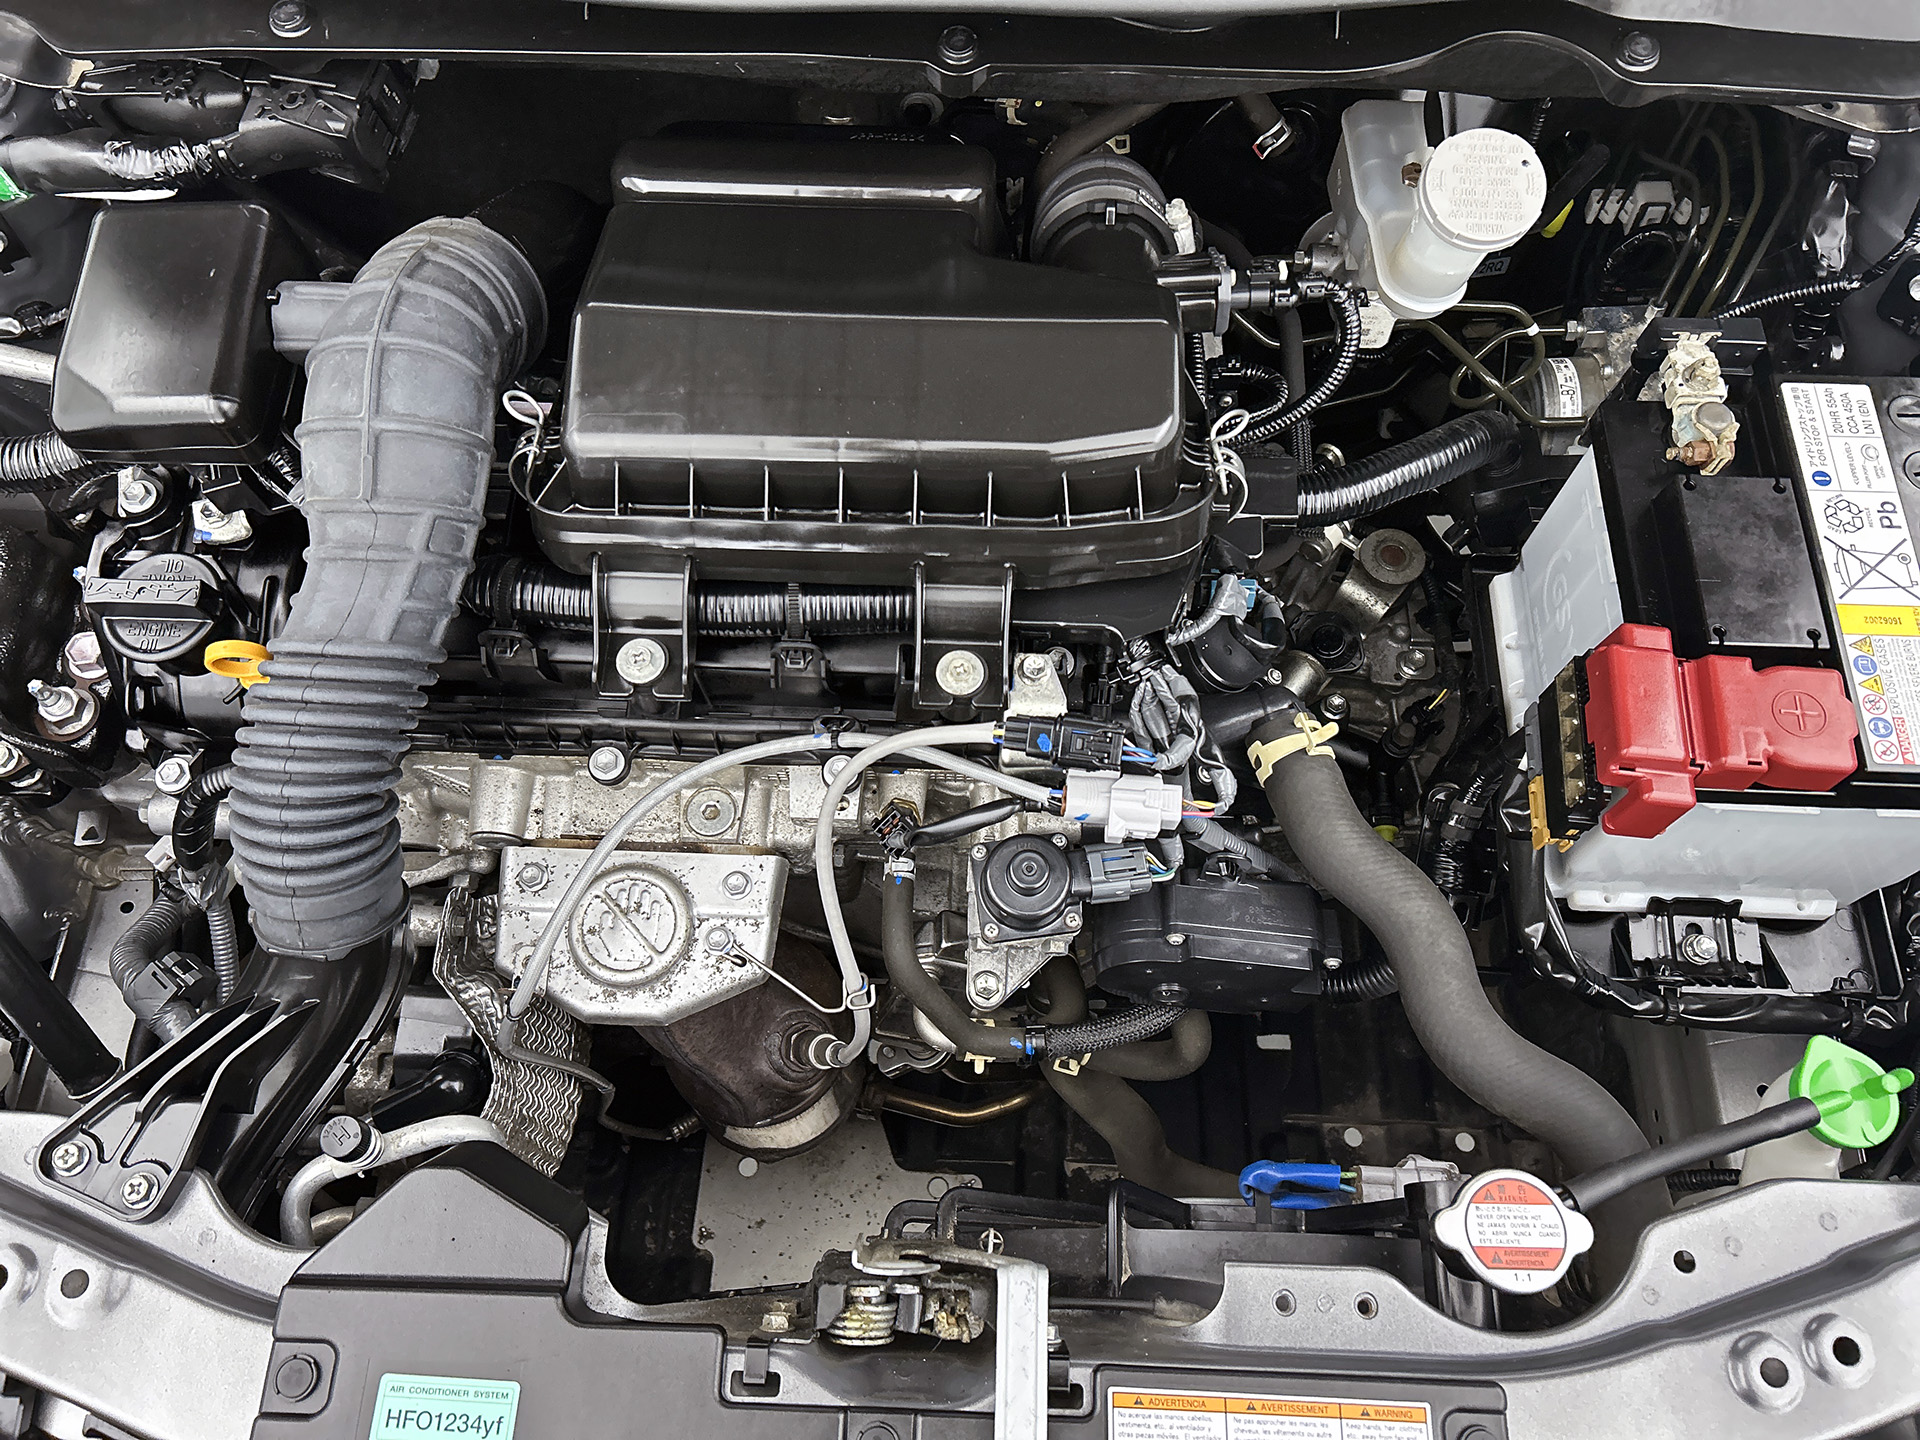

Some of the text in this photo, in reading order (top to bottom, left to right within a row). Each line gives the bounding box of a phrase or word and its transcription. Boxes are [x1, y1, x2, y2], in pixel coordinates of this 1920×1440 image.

[1466, 223, 1504, 234] WARNING
[1801, 389, 1814, 414] START
[1824, 387, 1844, 434] 20HR 55Ah
[1840, 392, 1859, 434] CCA 450A
[1856, 399, 1875, 435] LN1 (EN)
[1810, 424, 1823, 447] STOP
[1816, 448, 1828, 466] FOR
[1865, 507, 1874, 528] RECYCLE
[1877, 501, 1902, 529] Pb
[1827, 525, 1841, 534] LEAD
[161, 559, 184, 573] OIL
[127, 622, 183, 638] ENGINE
[139, 638, 160, 652] OIL
[1902, 639, 1916, 661] BURNS
[1874, 638, 1912, 753] DANGER EXPLOSIVE GASES
[331, 1125, 351, 1146] H
[390, 1385, 509, 1400] AIR CONDITIONER SYSTEM
[1148, 1397, 1206, 1408] ADVERTENCIA
[1261, 1403, 1329, 1414] AVERTISSEMENT
[1374, 1409, 1413, 1419] WARNING
[385, 1409, 505, 1439] HFO1234yf
